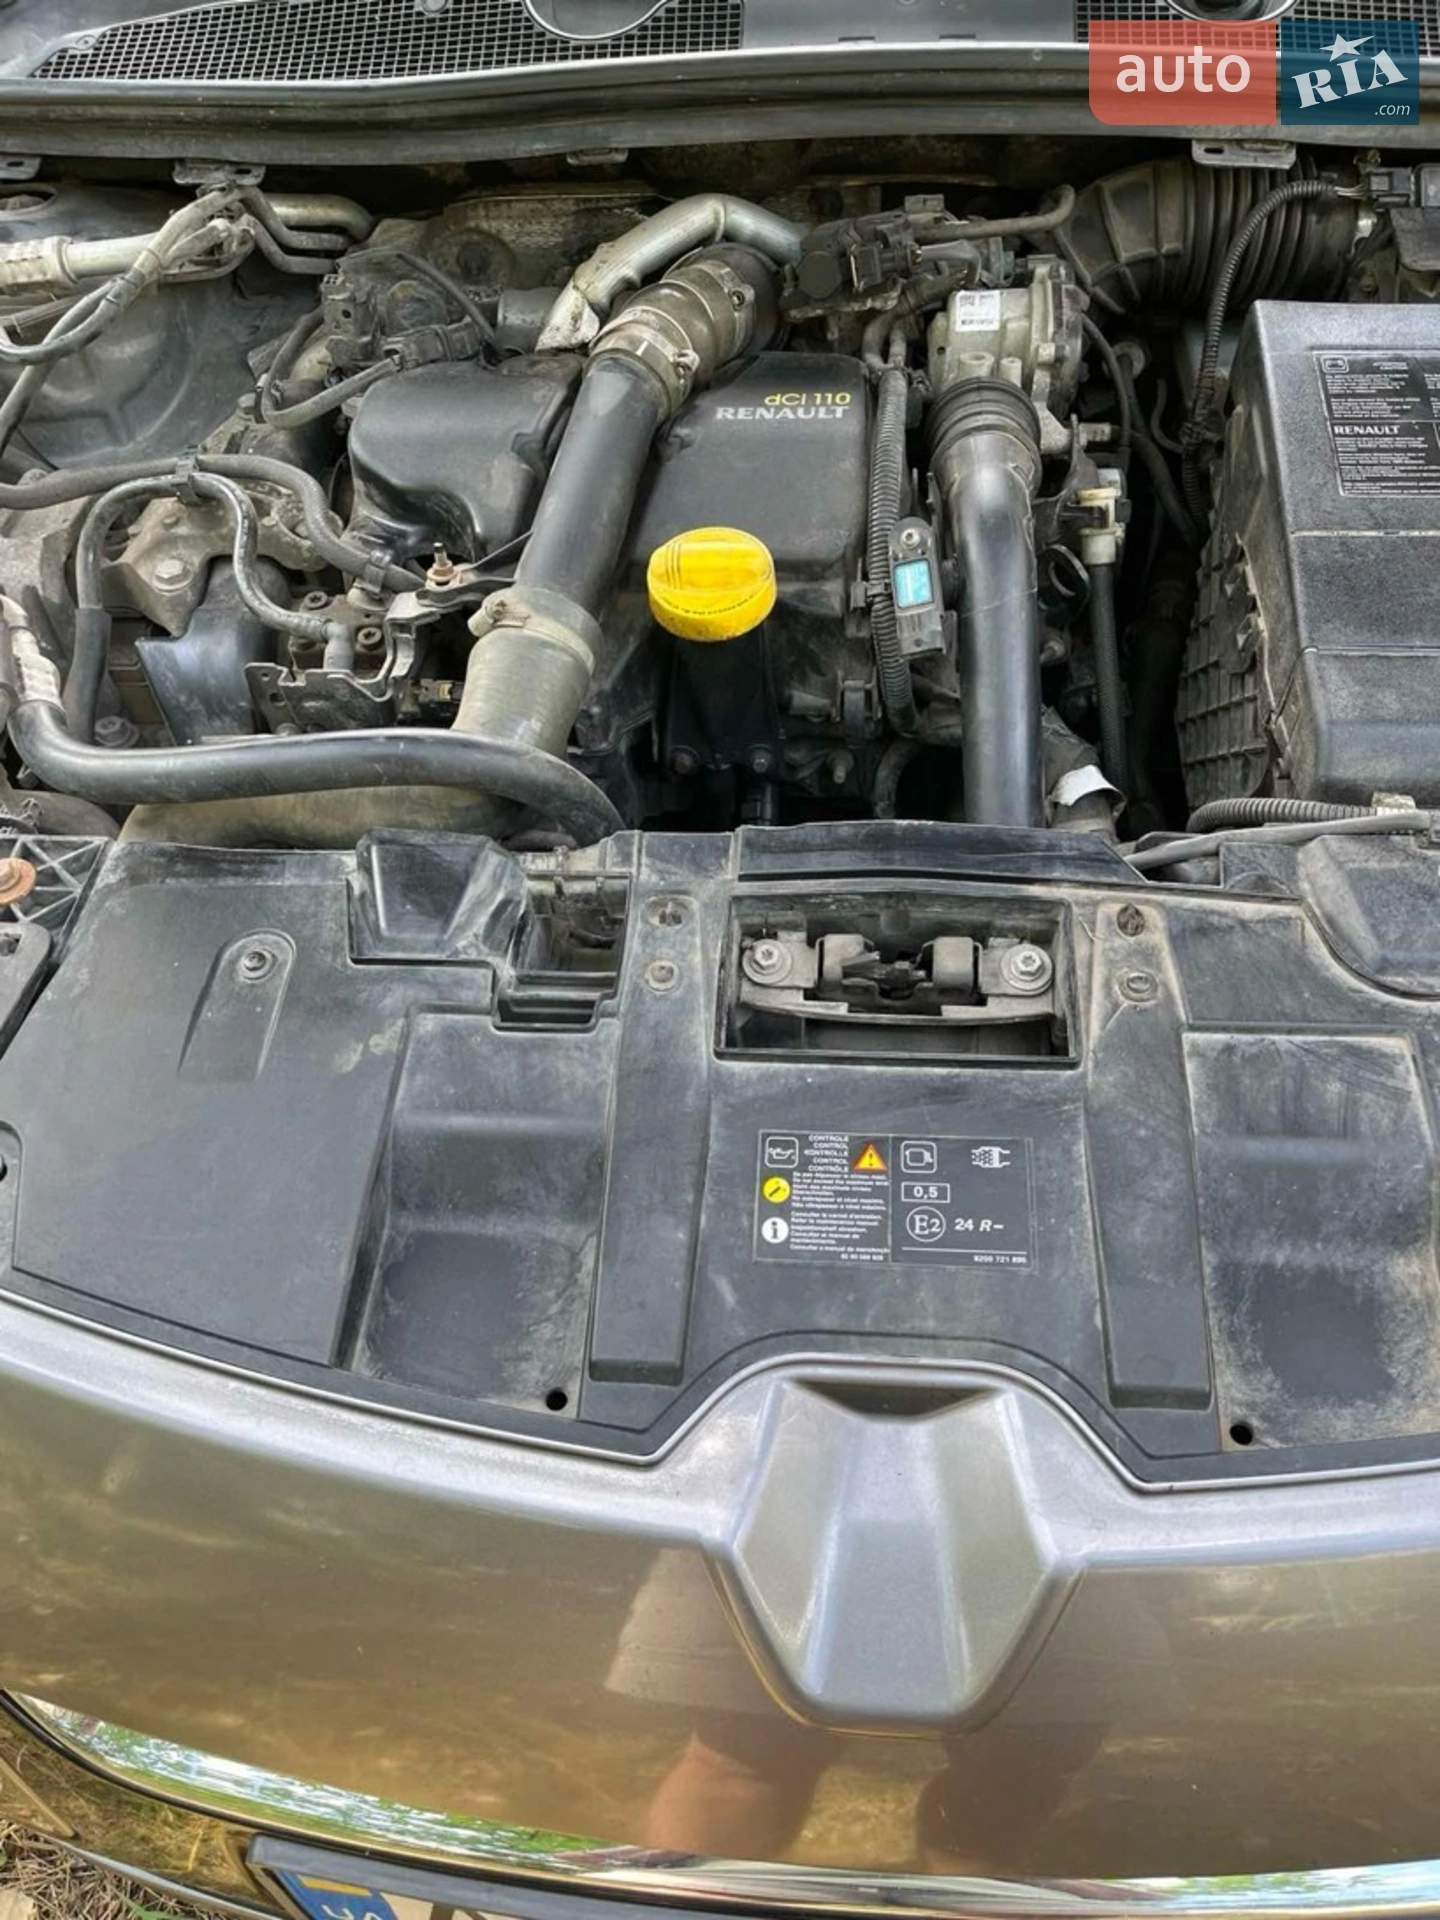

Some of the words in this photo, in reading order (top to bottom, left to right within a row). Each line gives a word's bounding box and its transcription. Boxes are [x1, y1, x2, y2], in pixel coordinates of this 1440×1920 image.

[814, 392, 851, 405] 110
[716, 406, 850, 420] RENAULT
[1333, 425, 1400, 435] RENAULT
[913, 1186, 938, 1199] 0,5
[913, 1214, 941, 1235] E2
[954, 1218, 974, 1231] 24
